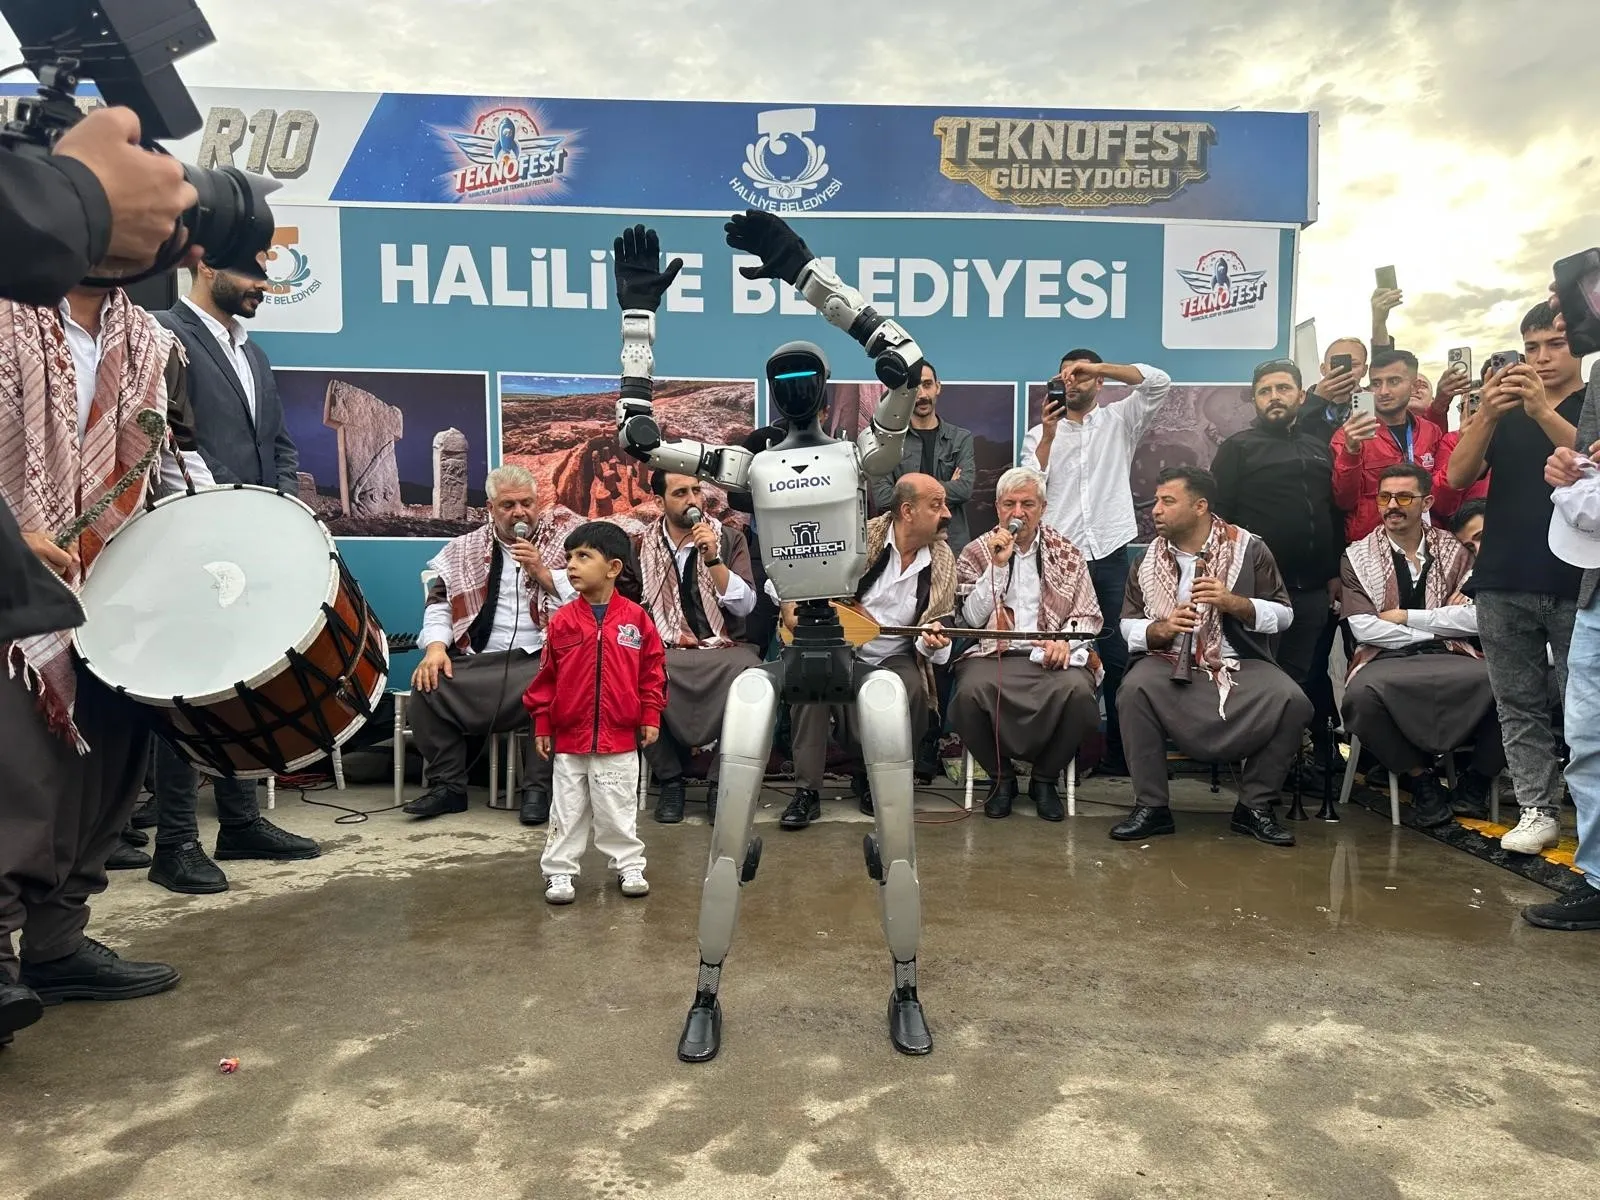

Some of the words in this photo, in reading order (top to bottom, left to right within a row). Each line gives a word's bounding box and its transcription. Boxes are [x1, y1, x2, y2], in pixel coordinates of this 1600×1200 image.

[197, 107, 319, 179] R10
[935, 118, 1214, 163] TEKNOFEST
[454, 148, 568, 193] TEKNOFEST
[990, 164, 1170, 189] GÜNEYDOĞU
[729, 177, 777, 212] HALİLİYE
[780, 178, 843, 212] BELEDİYESİ
[274, 279, 322, 305] BELEDİYESİ
[380, 243, 704, 313] HALİLİE
[732, 254, 1127, 320] BEEDİYESİ
[1181, 281, 1267, 318] TEKNOFEST
[769, 475, 831, 493] LOGIRON
[772, 541, 845, 557] ENTERTECH
